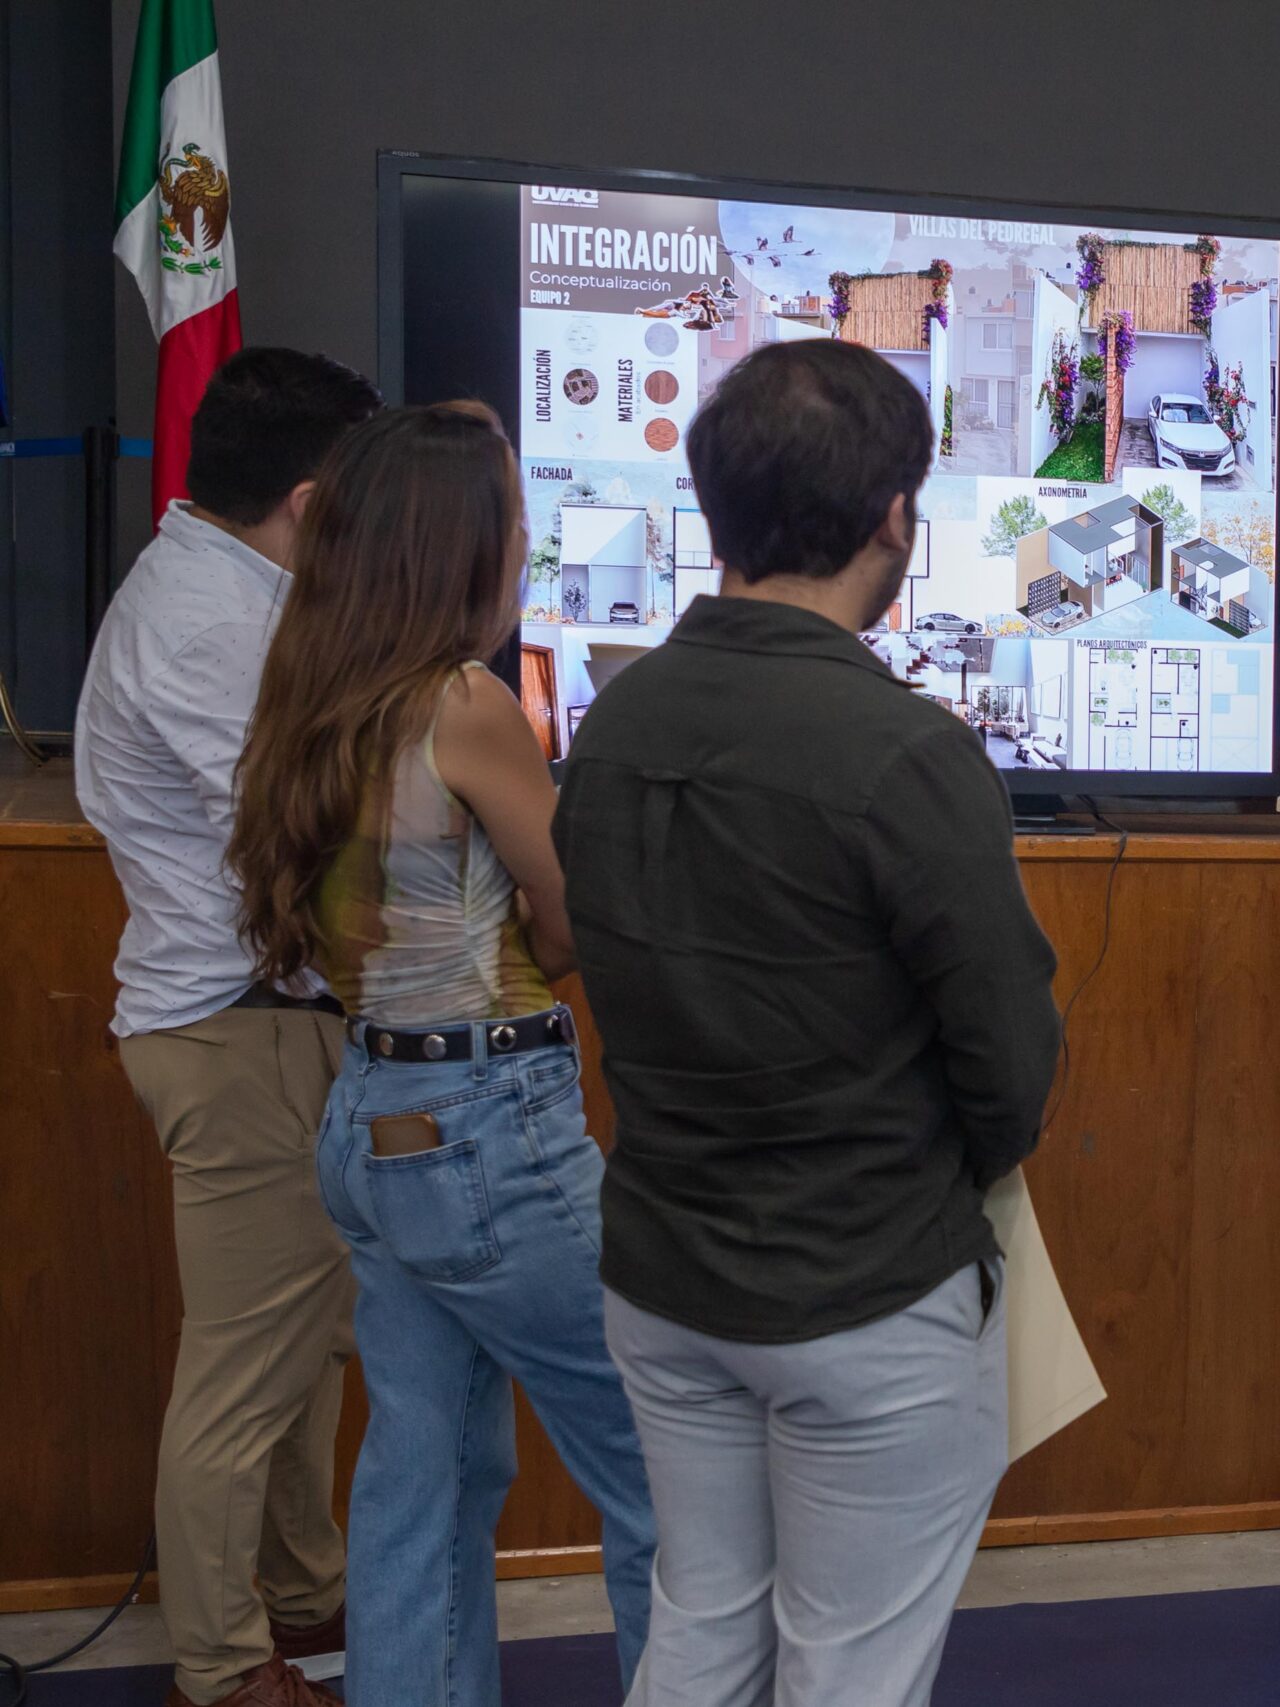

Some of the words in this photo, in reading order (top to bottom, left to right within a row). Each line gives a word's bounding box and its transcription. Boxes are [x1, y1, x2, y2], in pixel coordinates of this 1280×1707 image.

[909, 214, 957, 239] VILLAS
[959, 217, 986, 241] DEL
[988, 219, 1057, 246] PEDREGAL
[530, 222, 718, 276] INTEGRACIÓN
[529, 270, 671, 292] Conceptualización
[530, 289, 562, 305] EQUIPO
[563, 291, 571, 306] 2
[533, 349, 551, 423] LOCALIZACIÓN
[617, 358, 634, 423] MATERIALES
[530, 466, 573, 481] FACHADA
[1076, 639, 1098, 648] PLANOS
